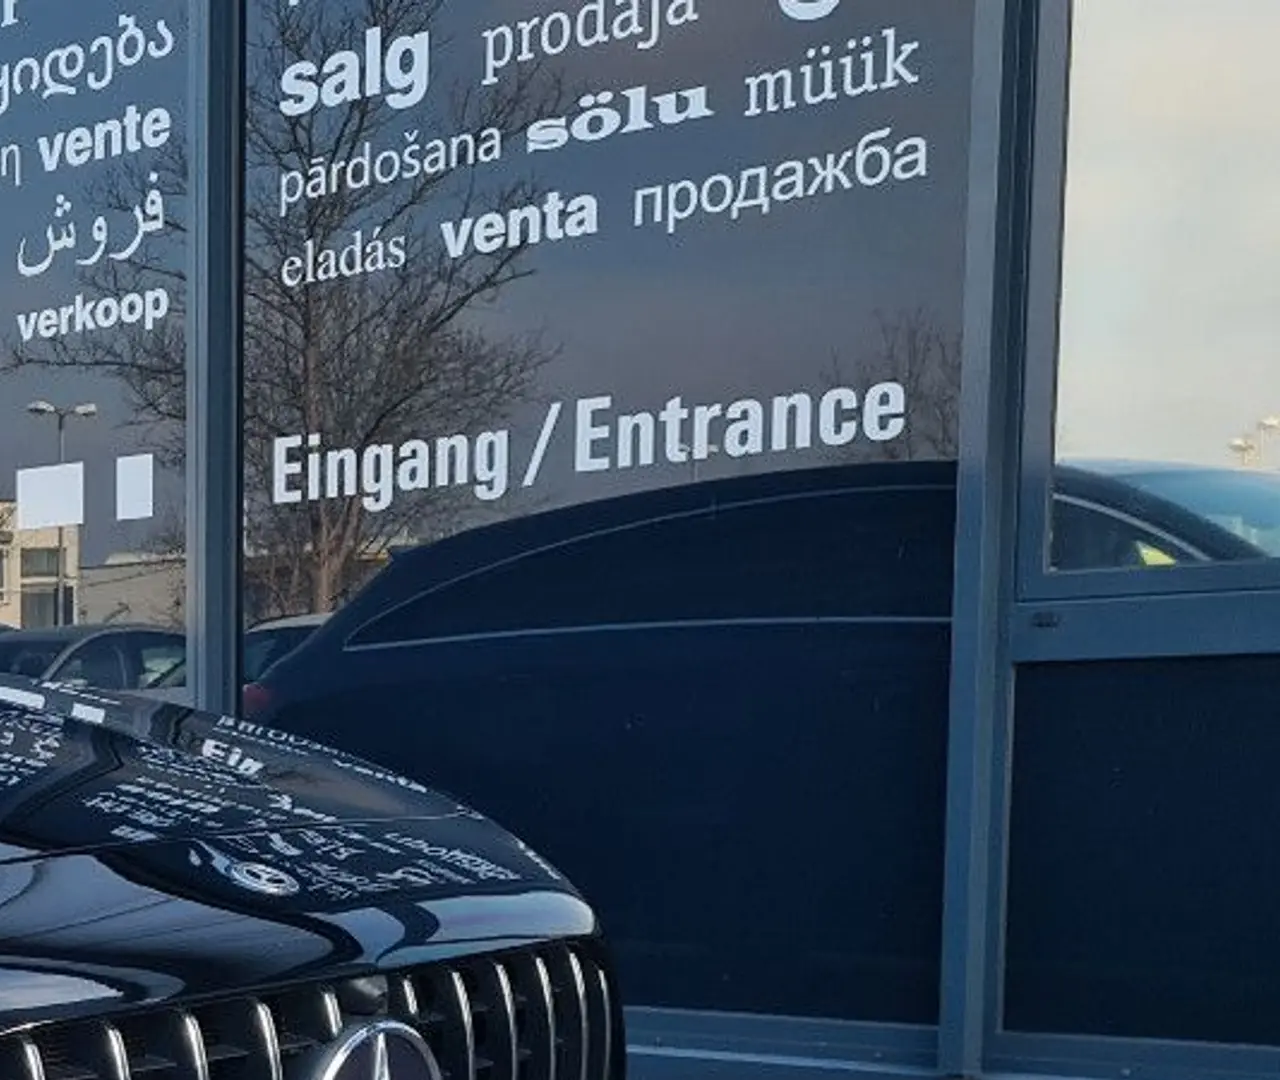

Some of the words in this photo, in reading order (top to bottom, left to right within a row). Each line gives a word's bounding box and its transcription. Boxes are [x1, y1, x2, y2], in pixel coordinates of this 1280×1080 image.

[280, 27, 428, 116] salg
[38, 108, 170, 171] vente
[281, 128, 500, 216] pārdošana
[527, 86, 714, 152] sölu
[745, 28, 918, 116] müük
[18, 172, 163, 277] فروش
[635, 128, 926, 233] продажба
[282, 227, 405, 286] eladás
[441, 195, 597, 257] venta
[17, 288, 168, 341] verkoop
[274, 430, 508, 512] Eingang
[575, 383, 904, 471] Entrance
